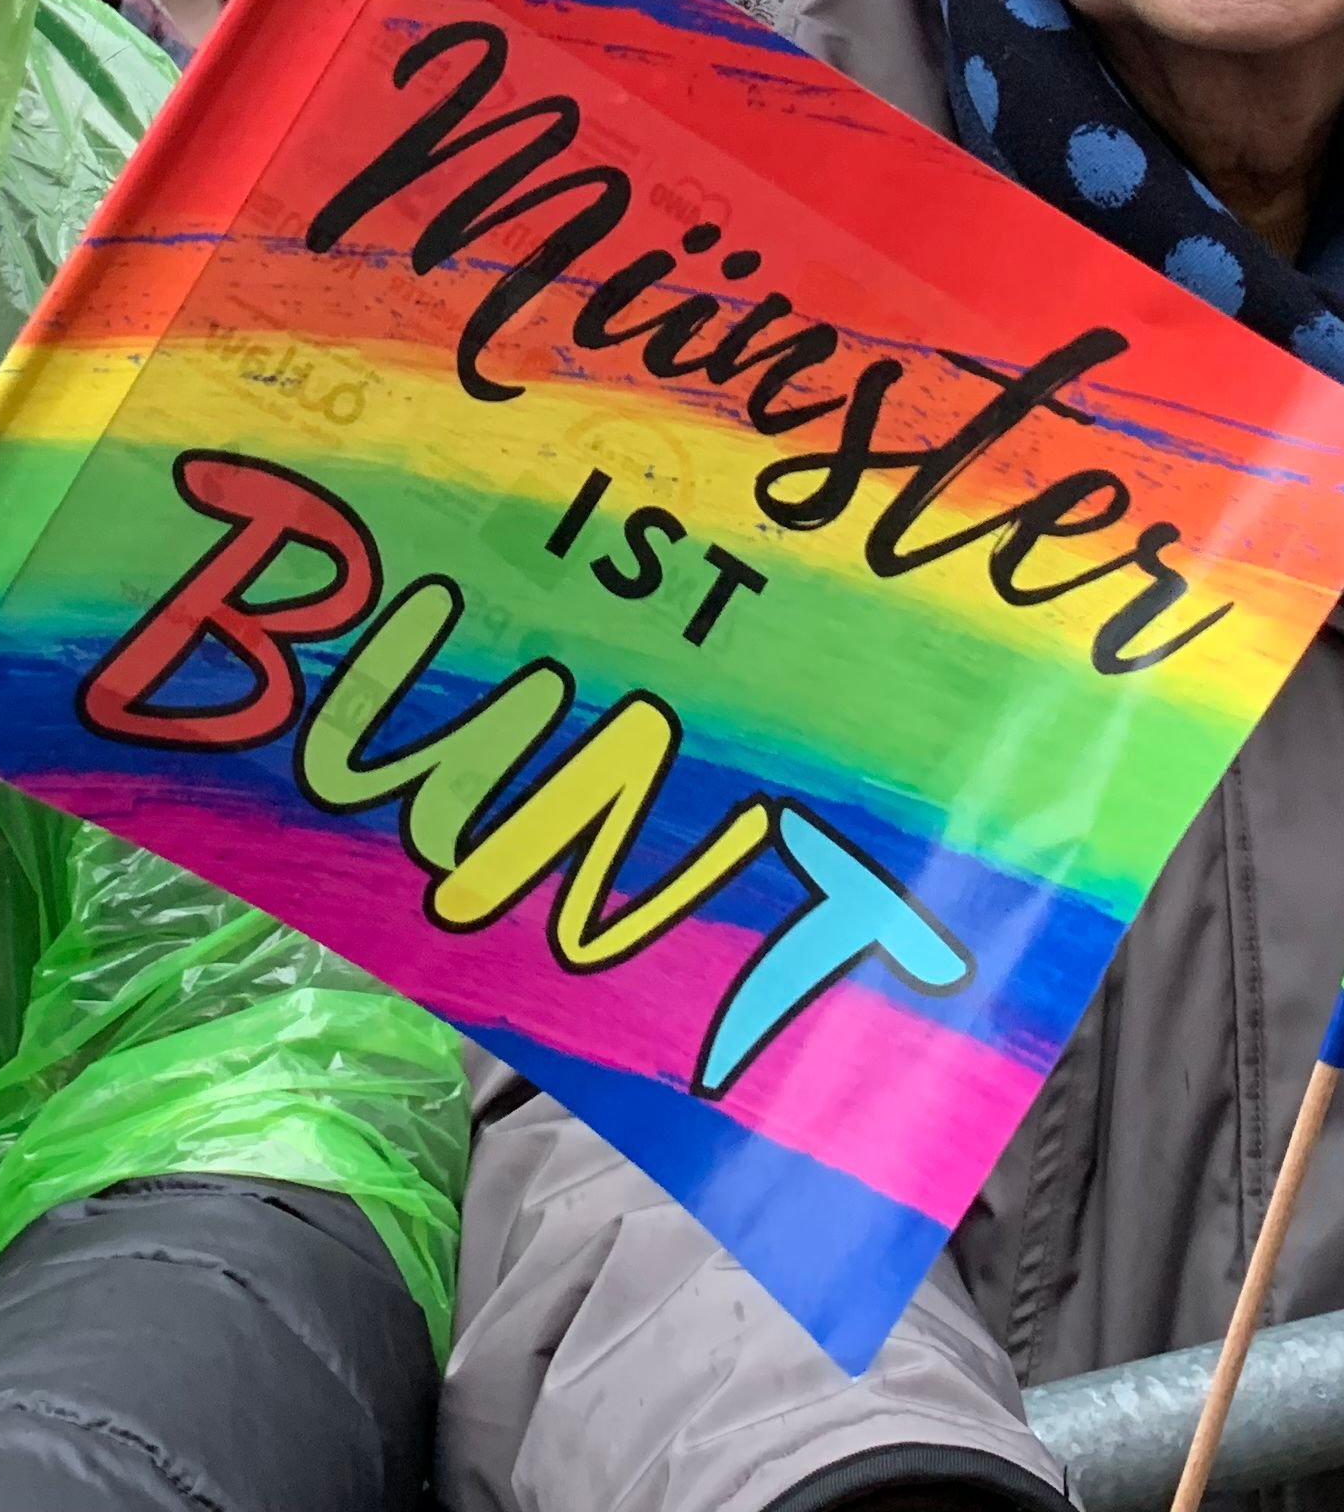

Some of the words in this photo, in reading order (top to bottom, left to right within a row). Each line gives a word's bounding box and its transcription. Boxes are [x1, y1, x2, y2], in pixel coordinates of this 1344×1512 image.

[306, 18, 1236, 679] Münster
[545, 469, 770, 649] IST
[75, 449, 977, 1099] BUNT
